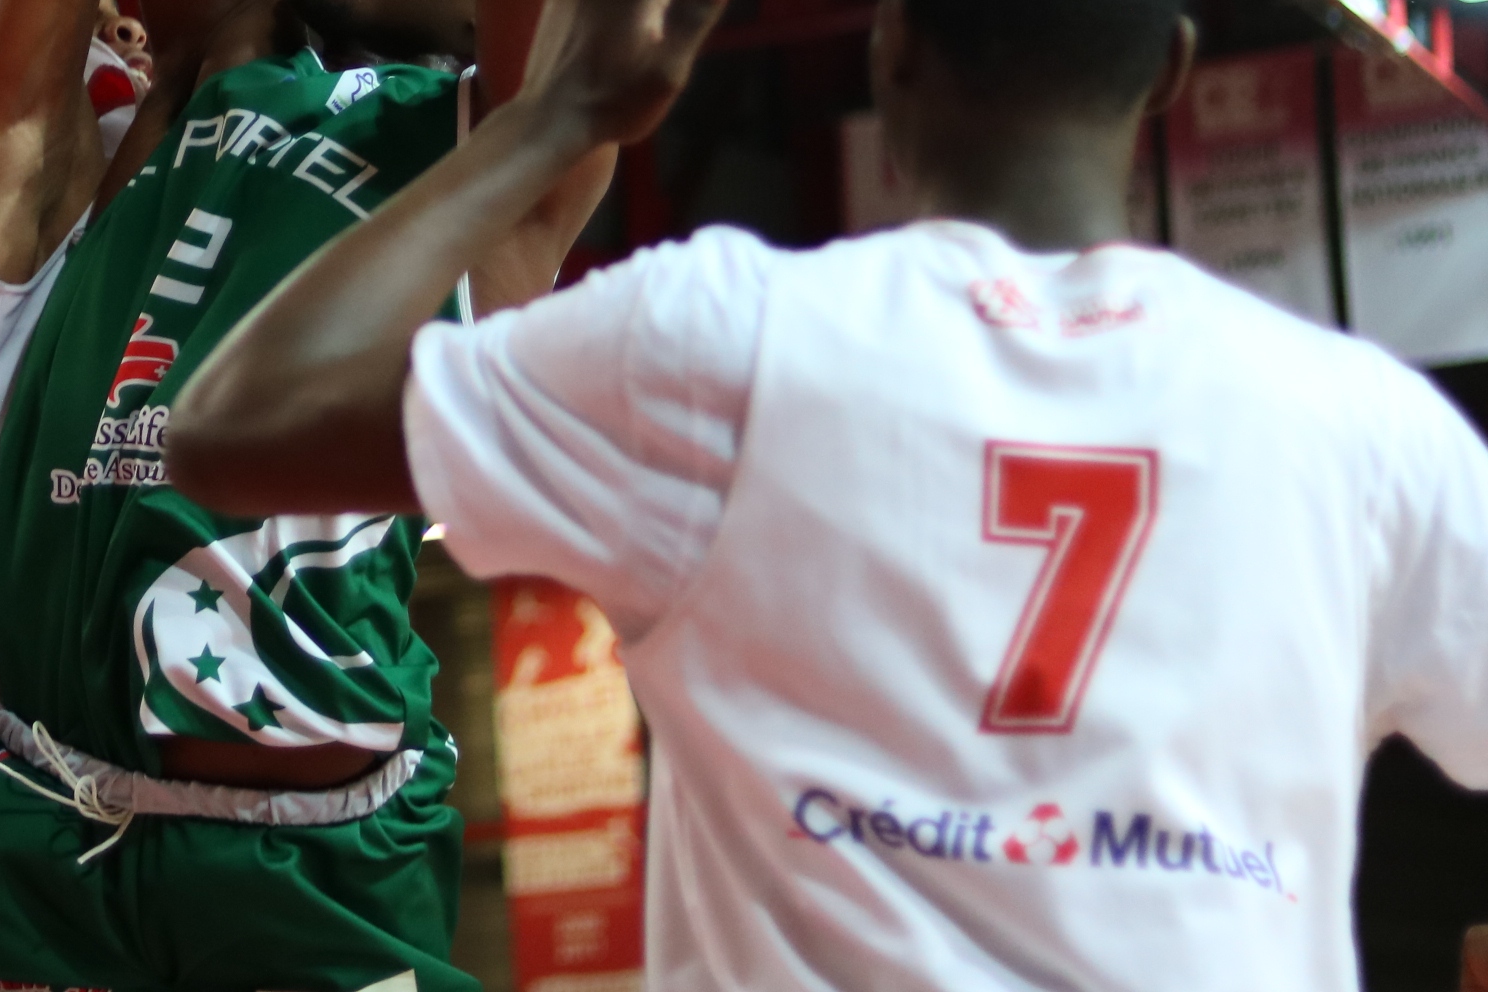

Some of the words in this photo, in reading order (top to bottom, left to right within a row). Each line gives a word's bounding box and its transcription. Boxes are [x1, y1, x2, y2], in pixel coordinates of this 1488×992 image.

[172, 107, 380, 222] PORTEL
[978, 439, 1160, 735] 7
[793, 788, 993, 862] Crédit
[1089, 810, 1284, 894] Mutuel
